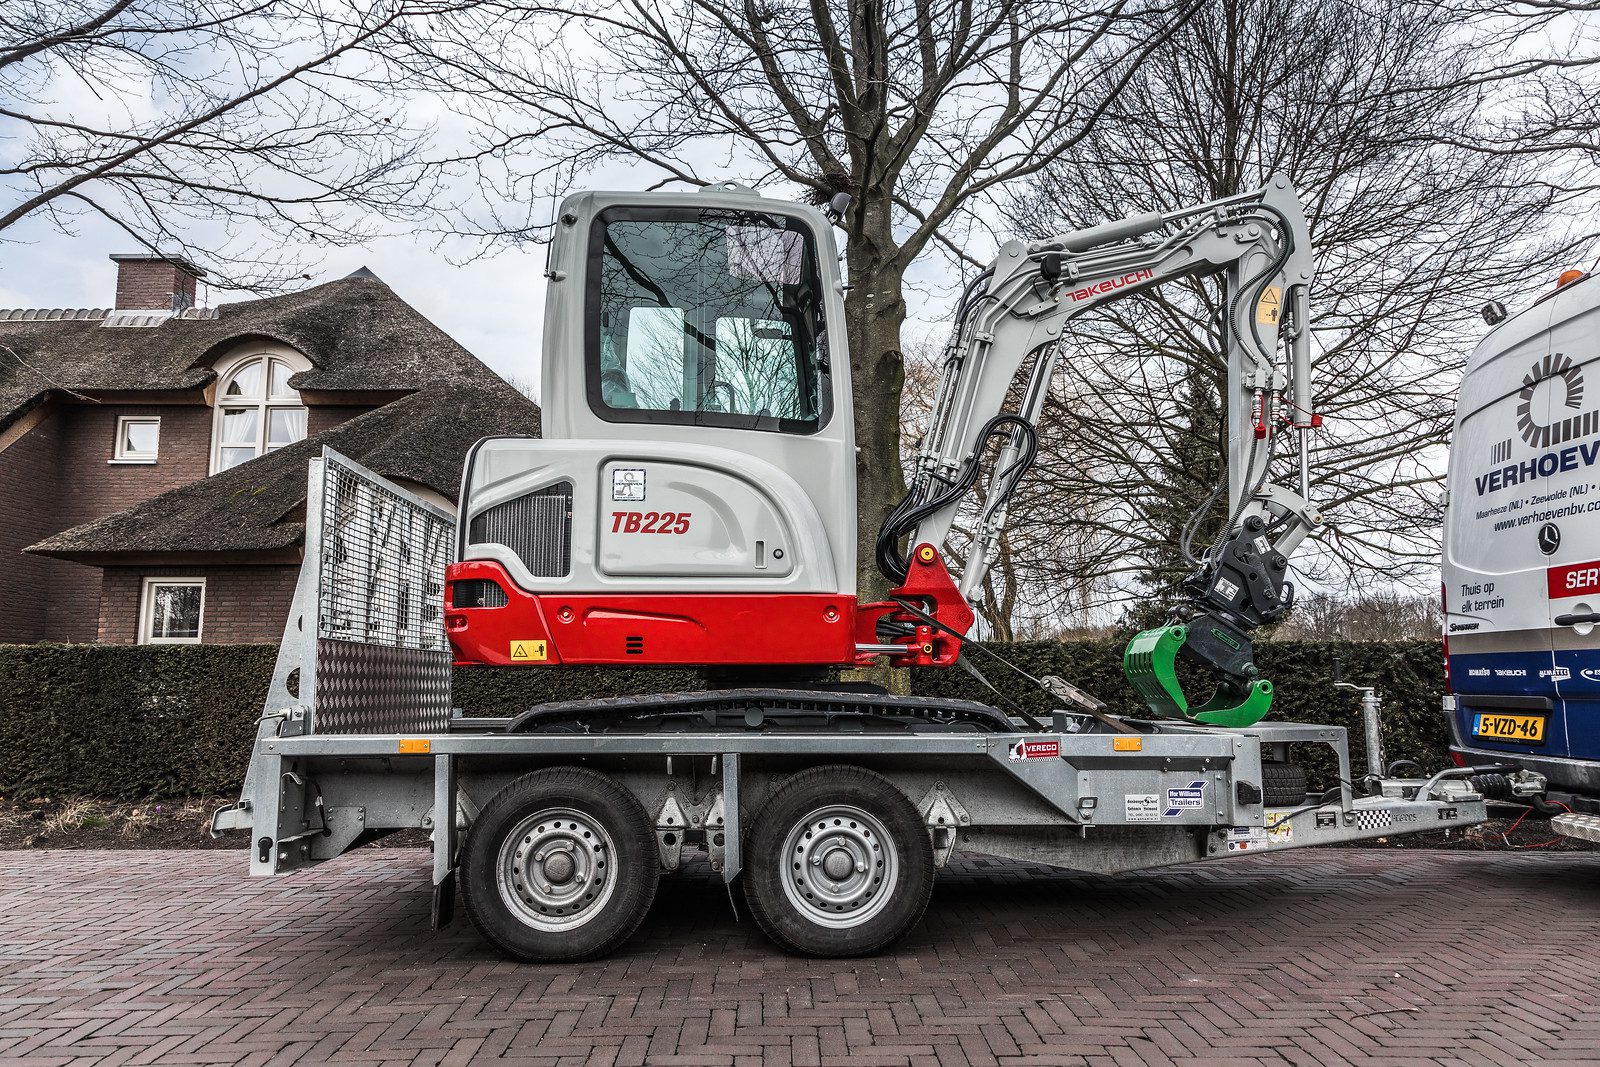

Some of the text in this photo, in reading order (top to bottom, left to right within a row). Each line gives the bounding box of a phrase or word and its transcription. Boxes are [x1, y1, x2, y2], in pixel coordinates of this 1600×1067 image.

[1065, 268, 1154, 302] TAKEUCHI
[1475, 440, 1600, 497] VERHOEV
[1475, 483, 1589, 520] Maarheeze (NL) Zeewolde (NL)
[611, 511, 692, 535] TB225
[1566, 568, 1600, 589] SER
[1461, 582, 1495, 597] Thuis op
[1461, 595, 1504, 613] elk terrein
[1481, 717, 1538, 738] 5-VZD-46
[1026, 744, 1057, 752] VERECO
